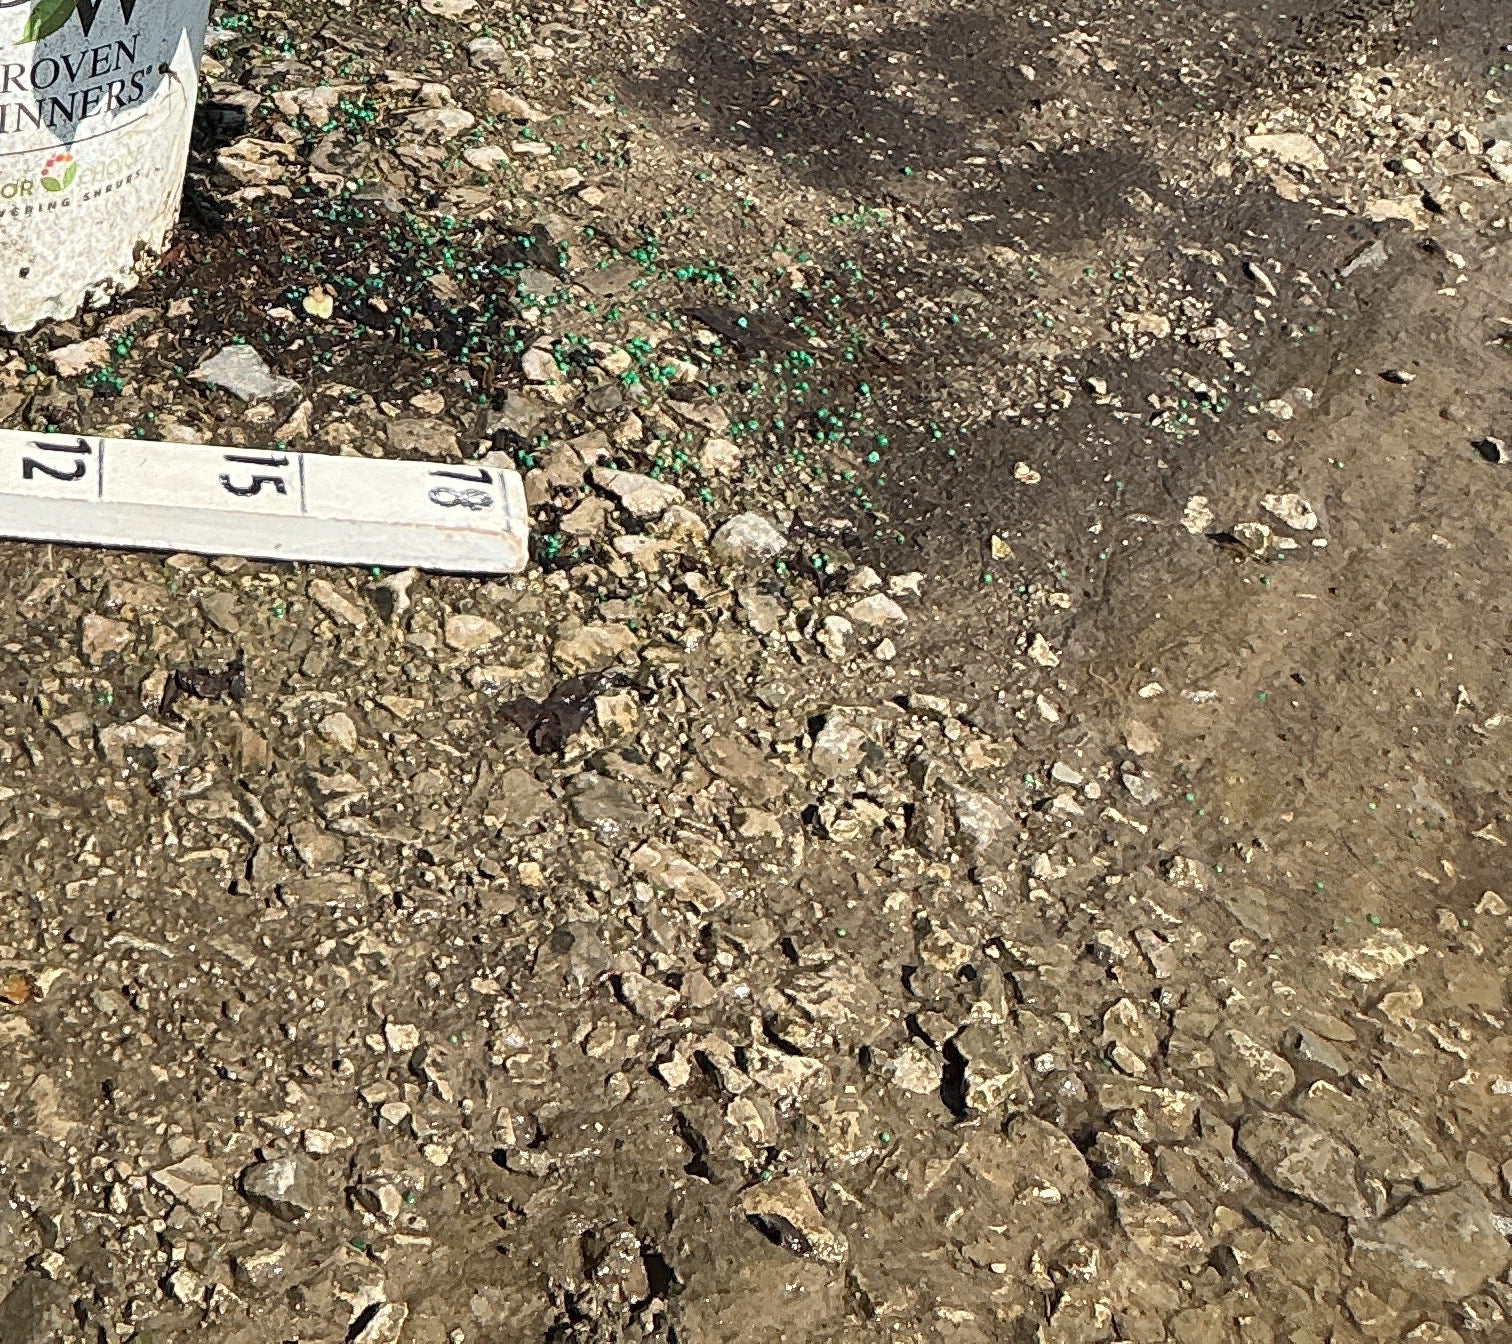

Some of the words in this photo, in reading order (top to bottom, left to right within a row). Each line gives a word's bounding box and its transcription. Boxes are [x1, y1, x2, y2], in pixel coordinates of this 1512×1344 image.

[22, 437, 93, 483] 12
[219, 453, 291, 497] 15
[428, 468, 495, 511] 18
